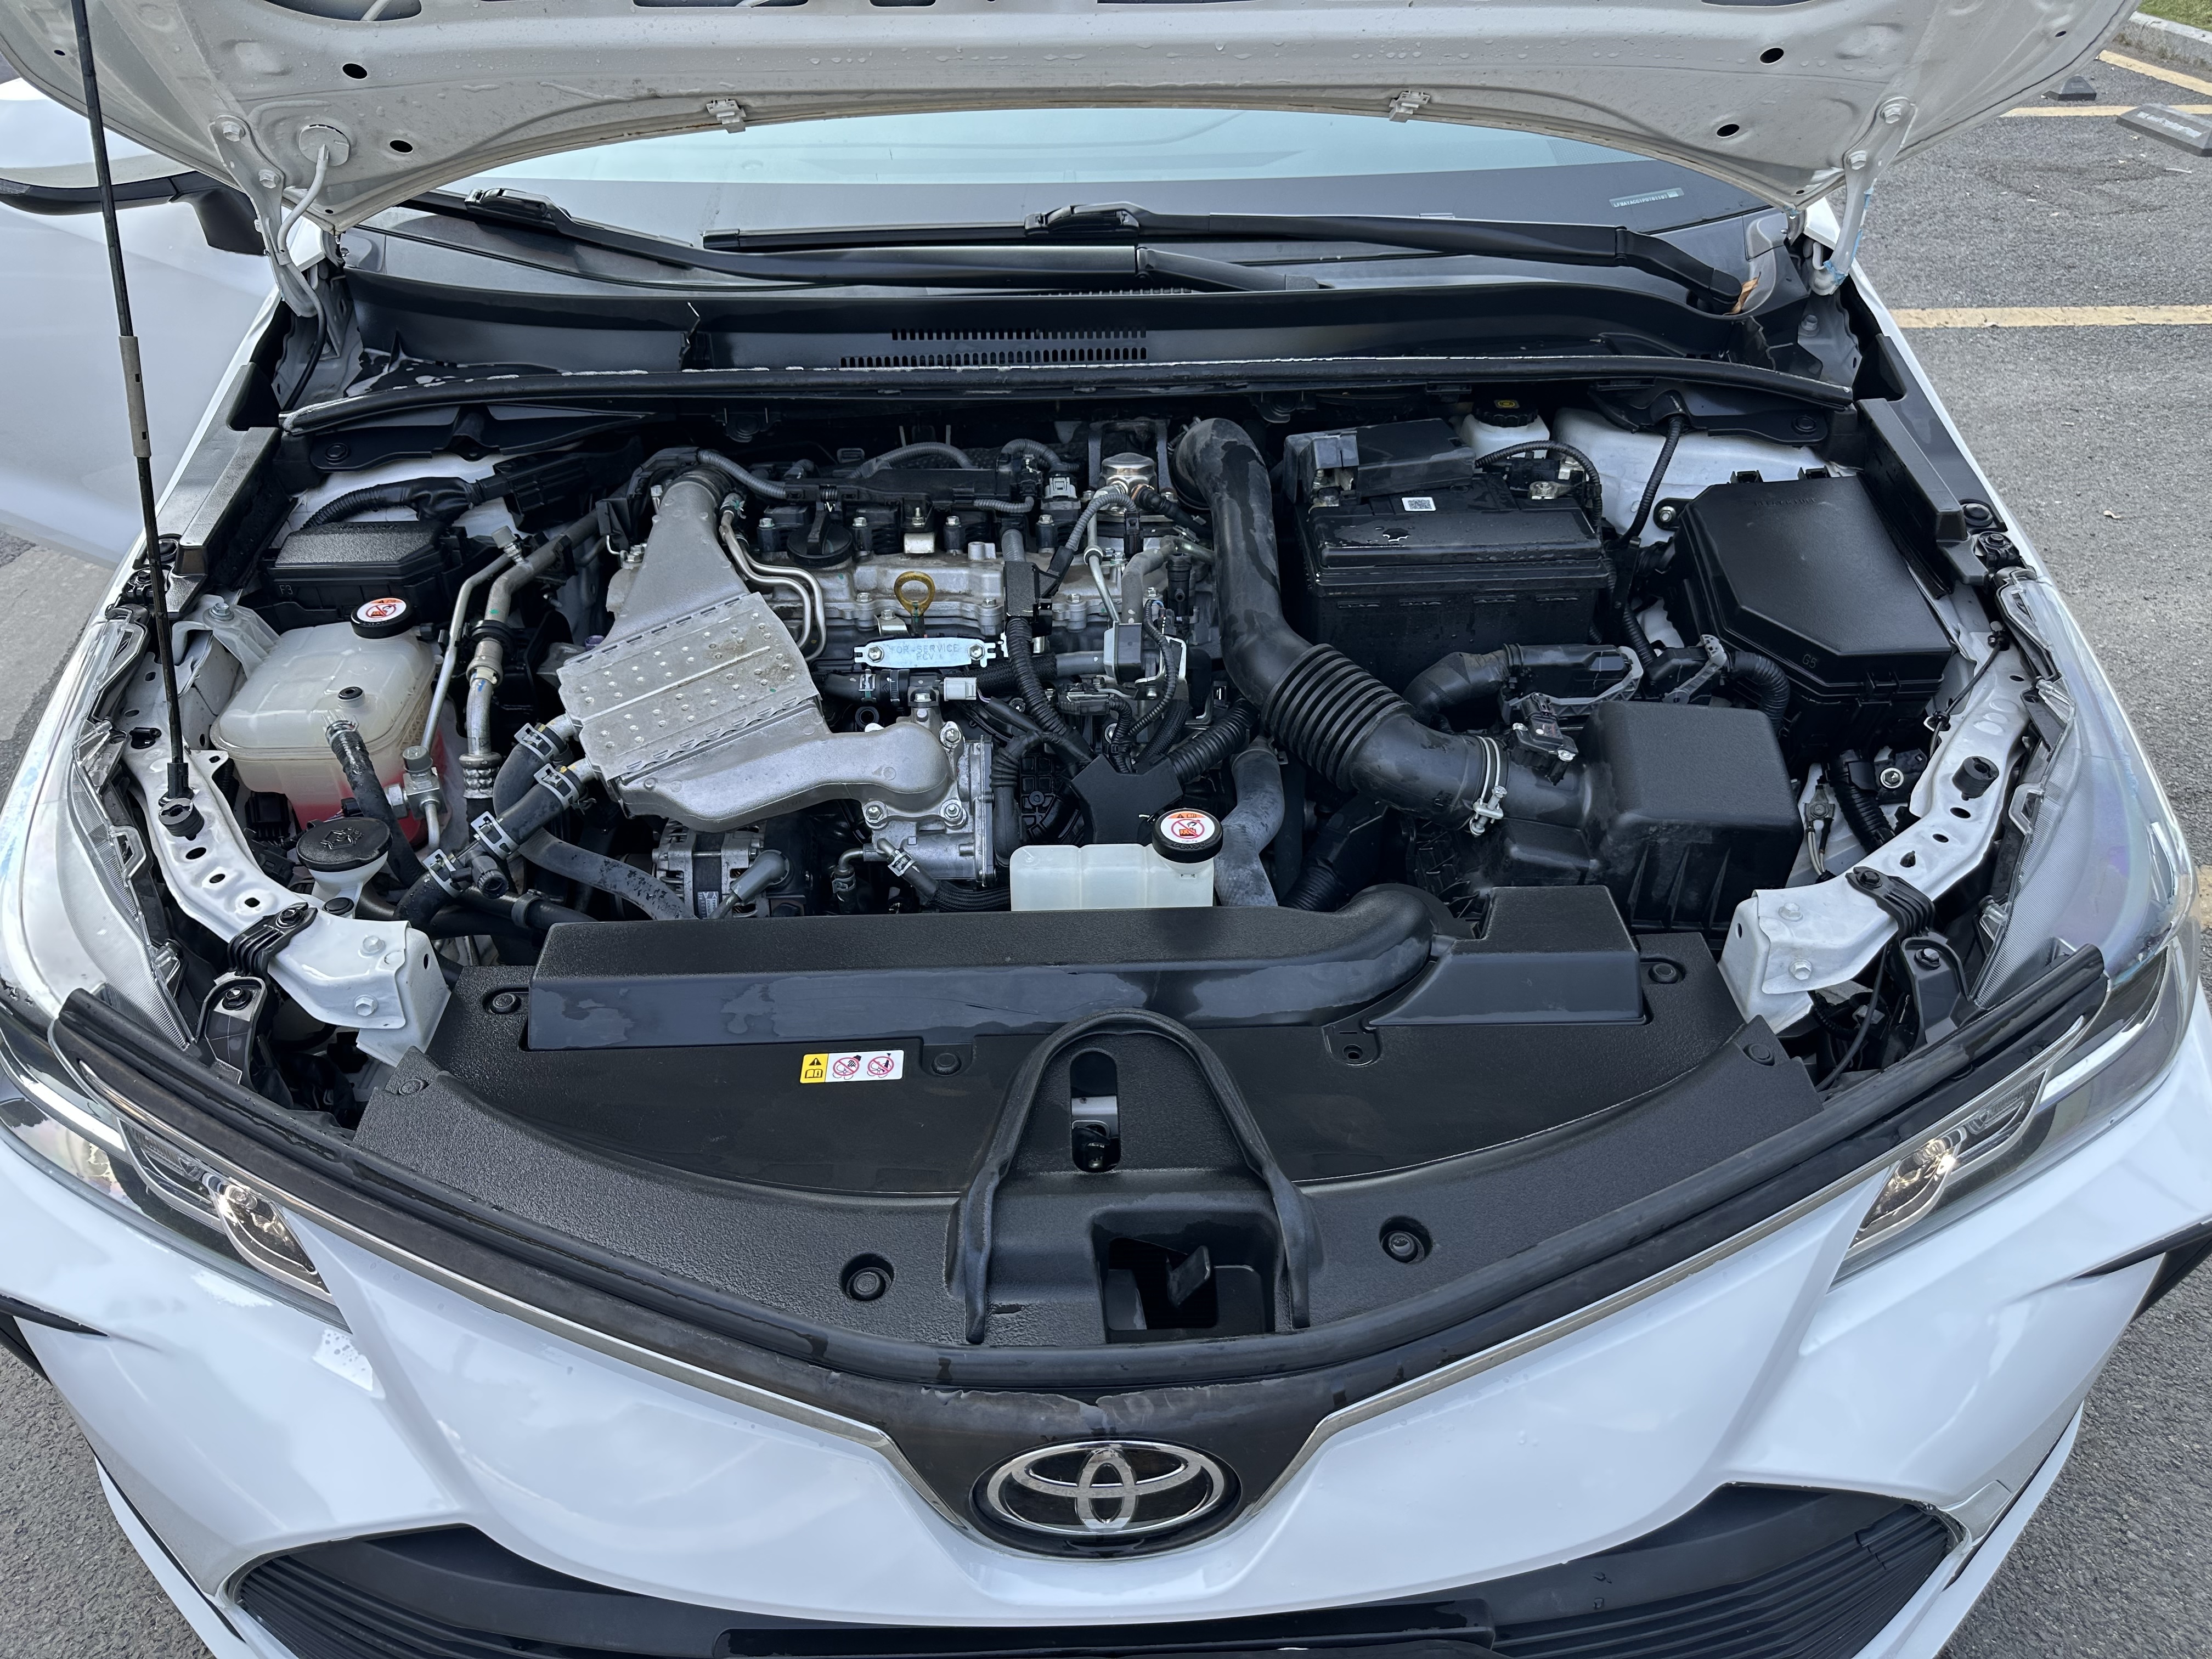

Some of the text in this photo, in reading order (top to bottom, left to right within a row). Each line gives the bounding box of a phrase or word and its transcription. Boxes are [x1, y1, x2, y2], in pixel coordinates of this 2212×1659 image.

[279, 584, 294, 595] F3
[890, 644, 960, 654] FOR SERVICE
[1802, 653, 1818, 668] G5
